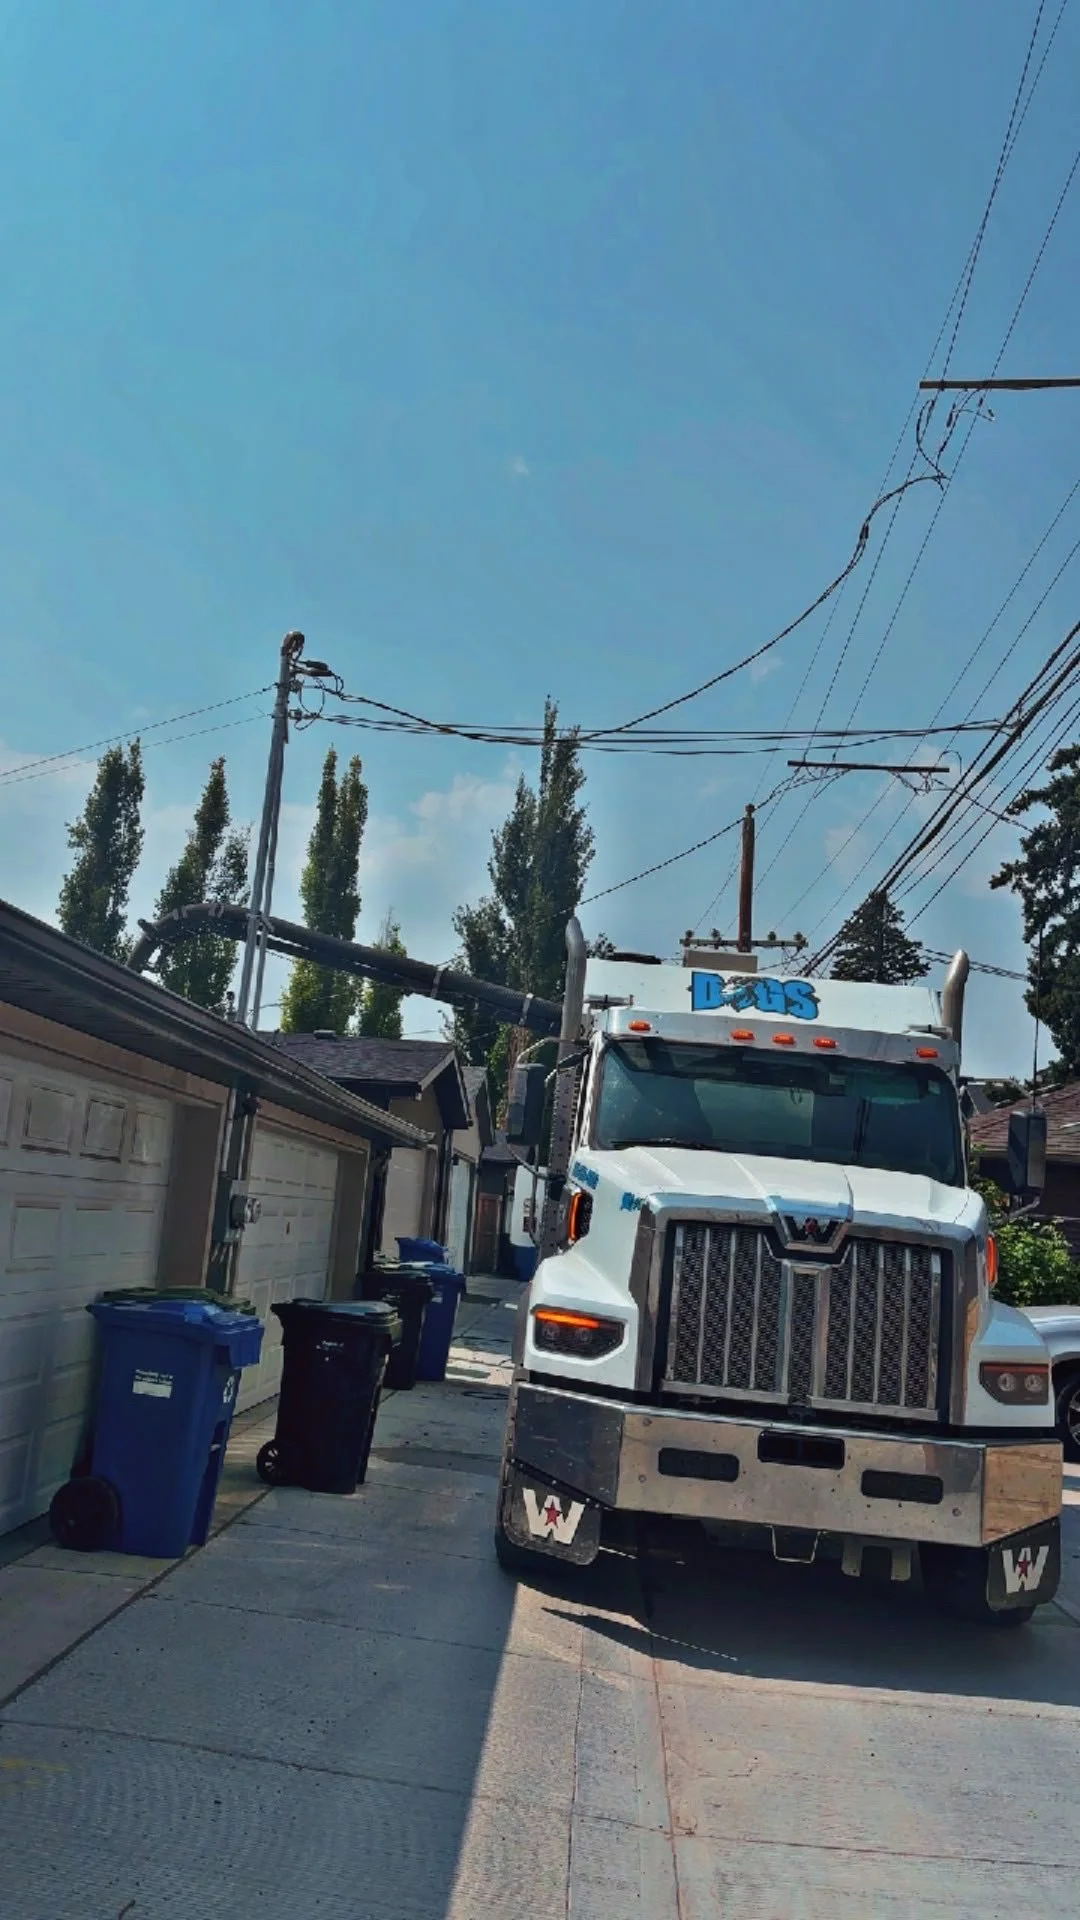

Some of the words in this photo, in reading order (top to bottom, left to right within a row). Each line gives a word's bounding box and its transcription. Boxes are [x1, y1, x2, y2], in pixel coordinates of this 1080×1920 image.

[691, 971, 819, 1020] DGS
[522, 1488, 585, 1545] W
[1002, 1546, 1049, 1594] W
